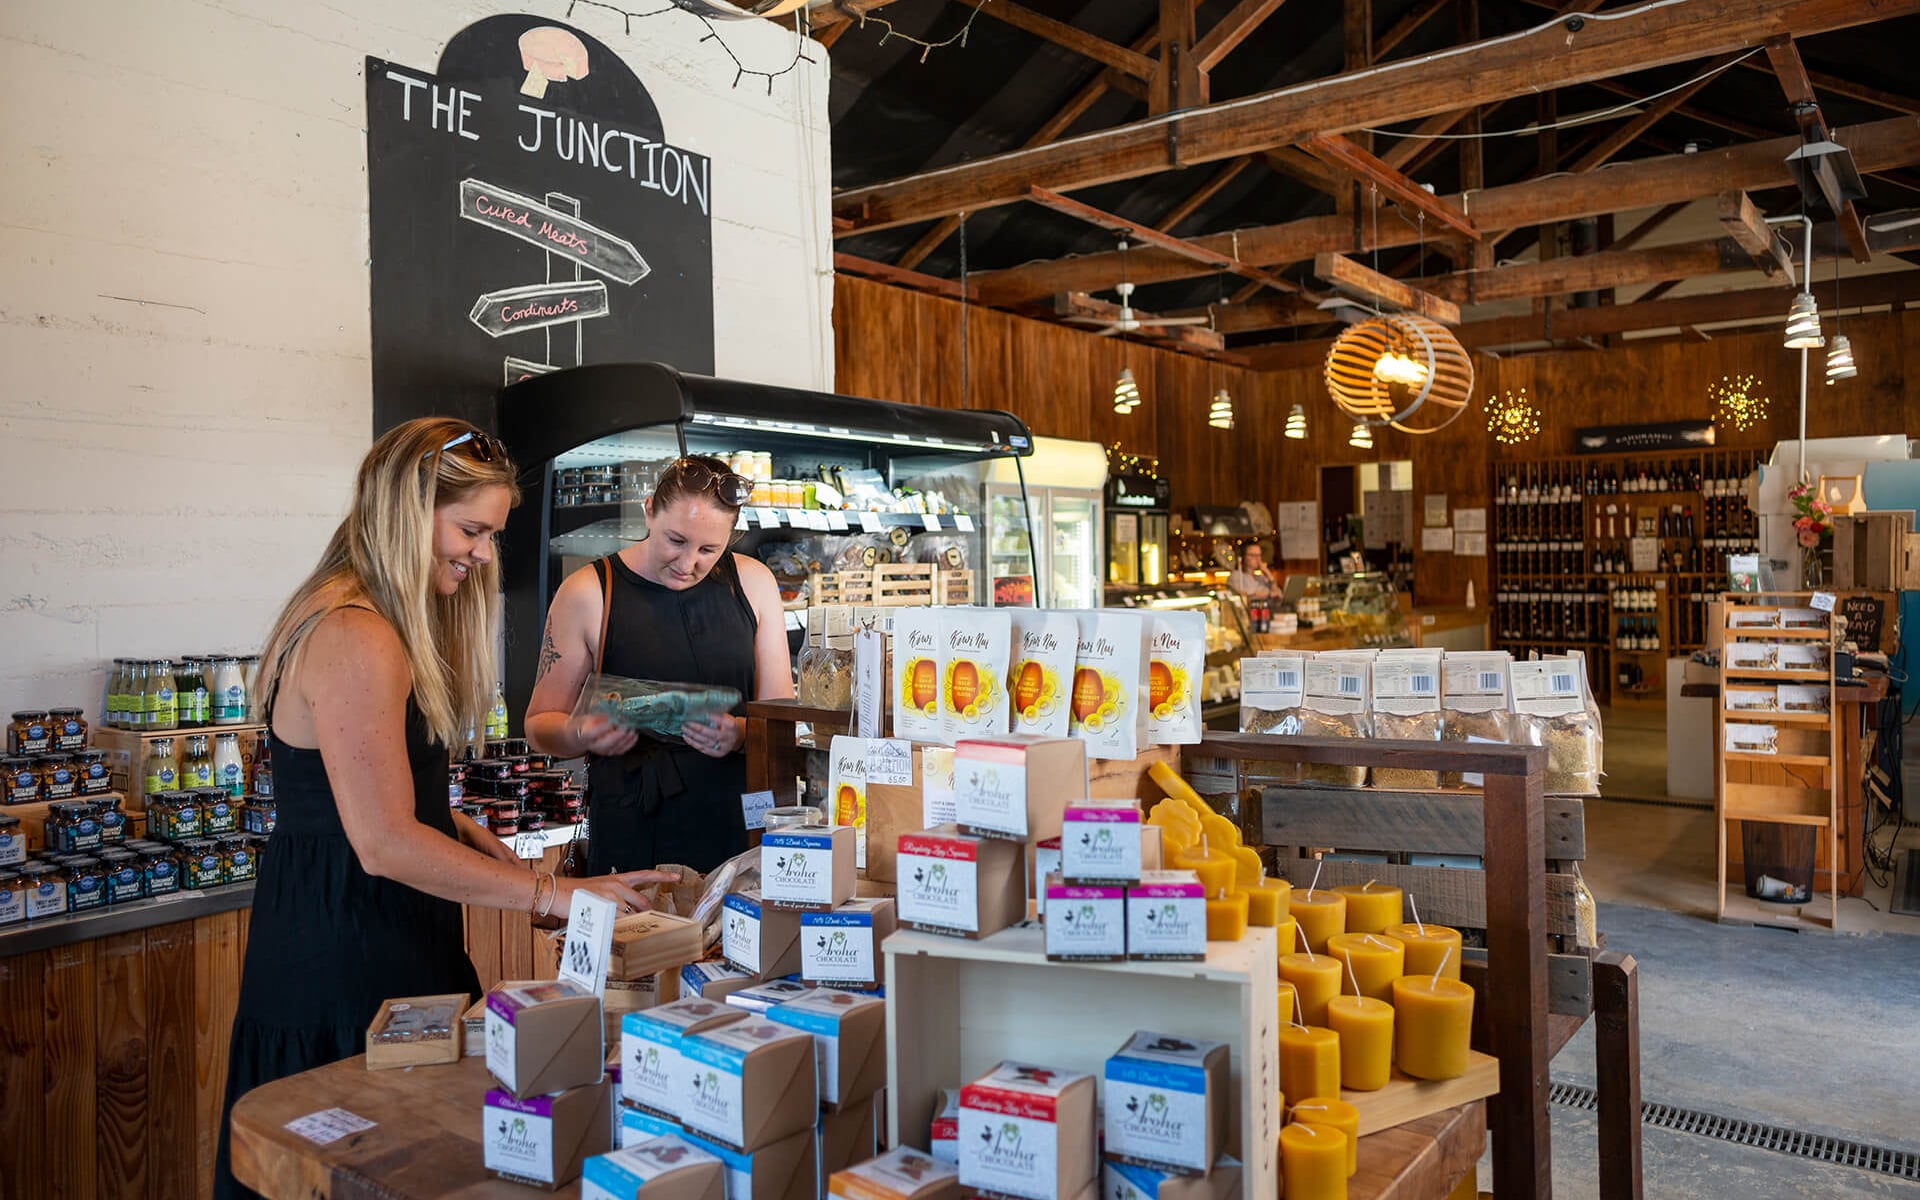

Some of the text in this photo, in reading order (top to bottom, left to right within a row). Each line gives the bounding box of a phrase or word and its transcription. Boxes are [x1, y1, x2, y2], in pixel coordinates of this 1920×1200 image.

[386, 71, 708, 216] THE JUNCTION
[476, 196, 588, 255] Cured Meats
[501, 297, 578, 322] Condiments
[1847, 602, 1876, 613] NEED
[855, 759, 866, 775] Nu
[775, 877, 816, 885] CHOCOLATE
[816, 955, 858, 964] CHOCOLATE
